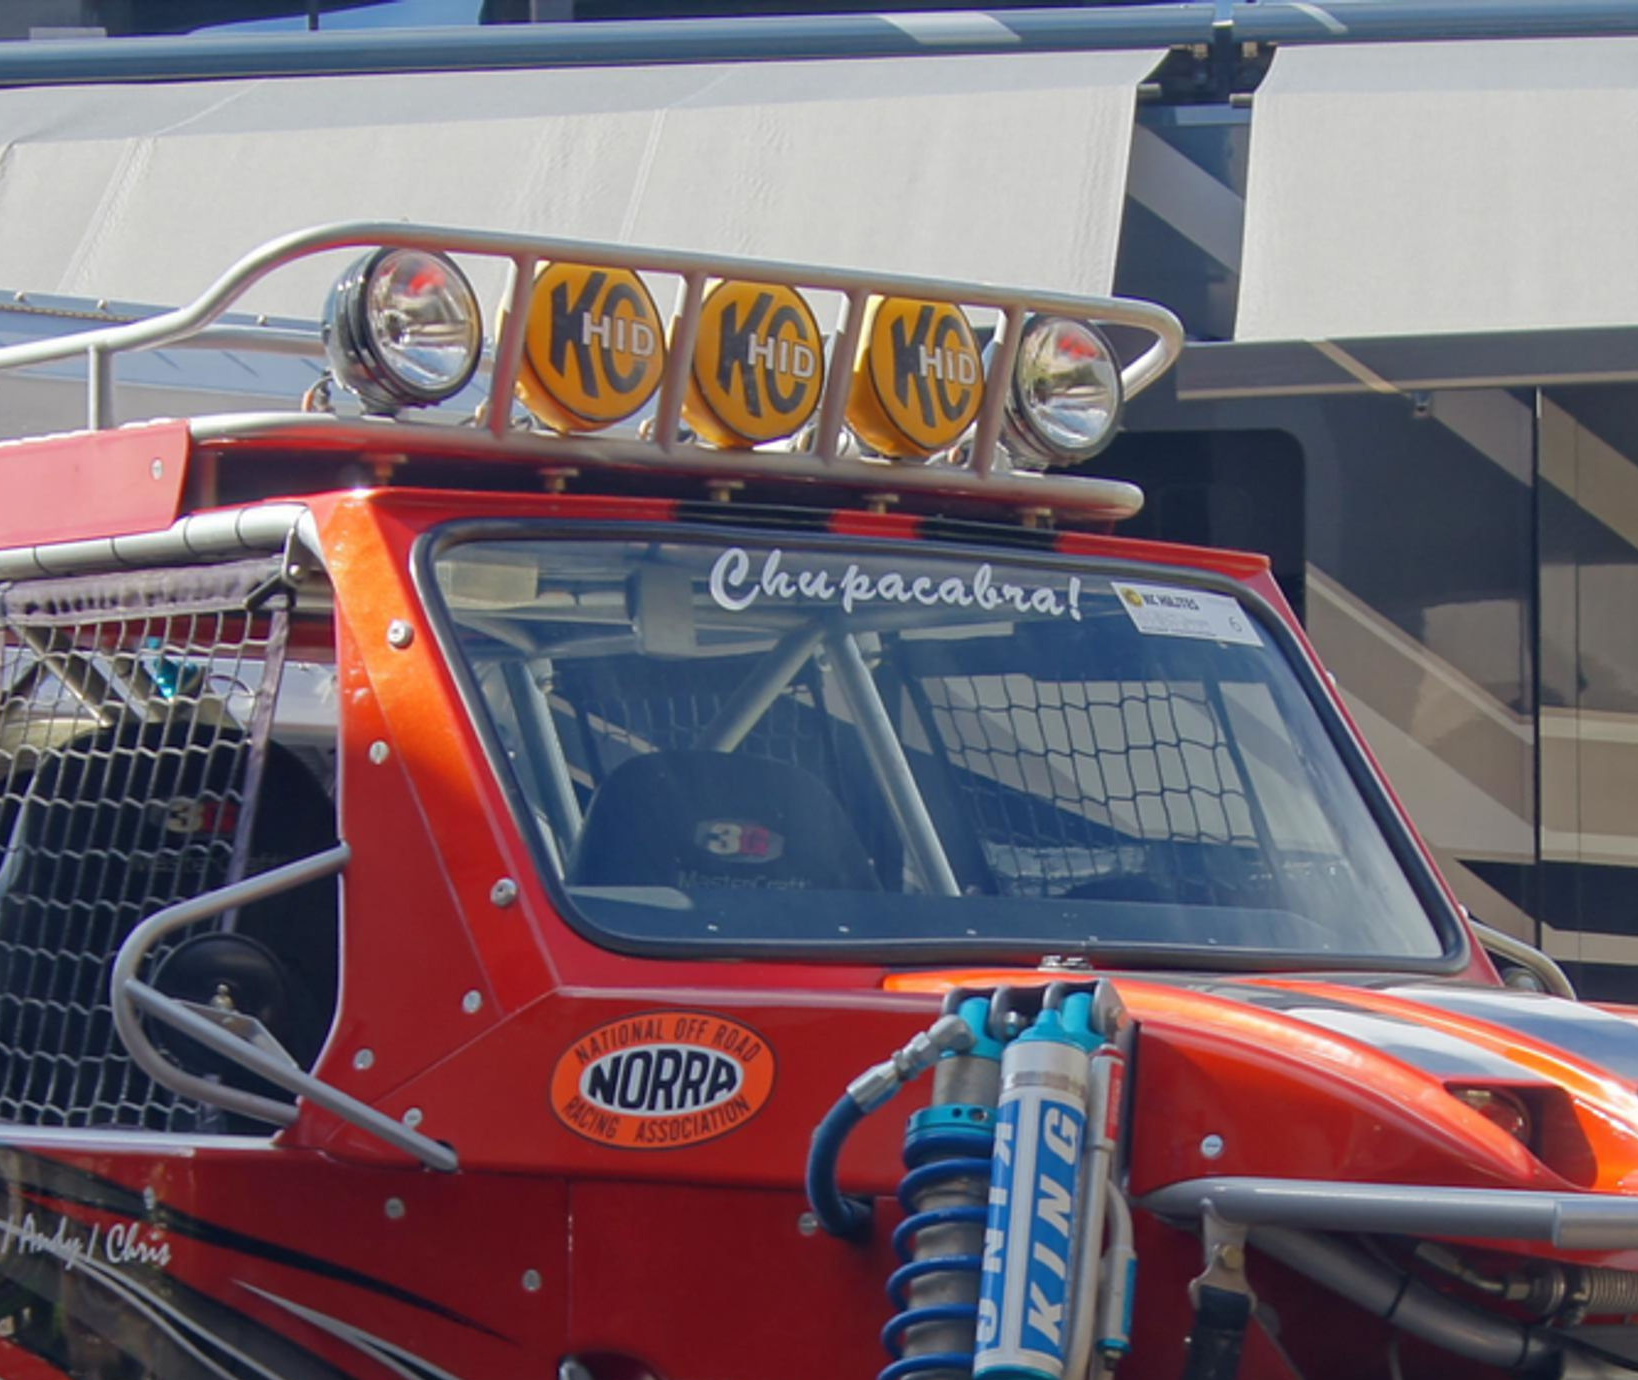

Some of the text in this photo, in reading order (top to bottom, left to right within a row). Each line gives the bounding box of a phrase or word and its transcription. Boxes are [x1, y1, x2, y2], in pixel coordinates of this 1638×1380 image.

[551, 271, 646, 399] KC
[581, 310, 656, 357] HID
[717, 292, 807, 419] KC
[748, 331, 816, 380] HID
[892, 304, 971, 428] KC
[919, 343, 977, 386] HID
[709, 546, 1083, 622] Chupacabra!
[573, 1017, 762, 1064] NATIONAL OFF ROAD
[587, 1047, 739, 1112] NORRA
[563, 1094, 752, 1144] RACING ASSOCIATION
[105, 1221, 172, 1267] Chris
[1027, 1106, 1081, 1347] KING
